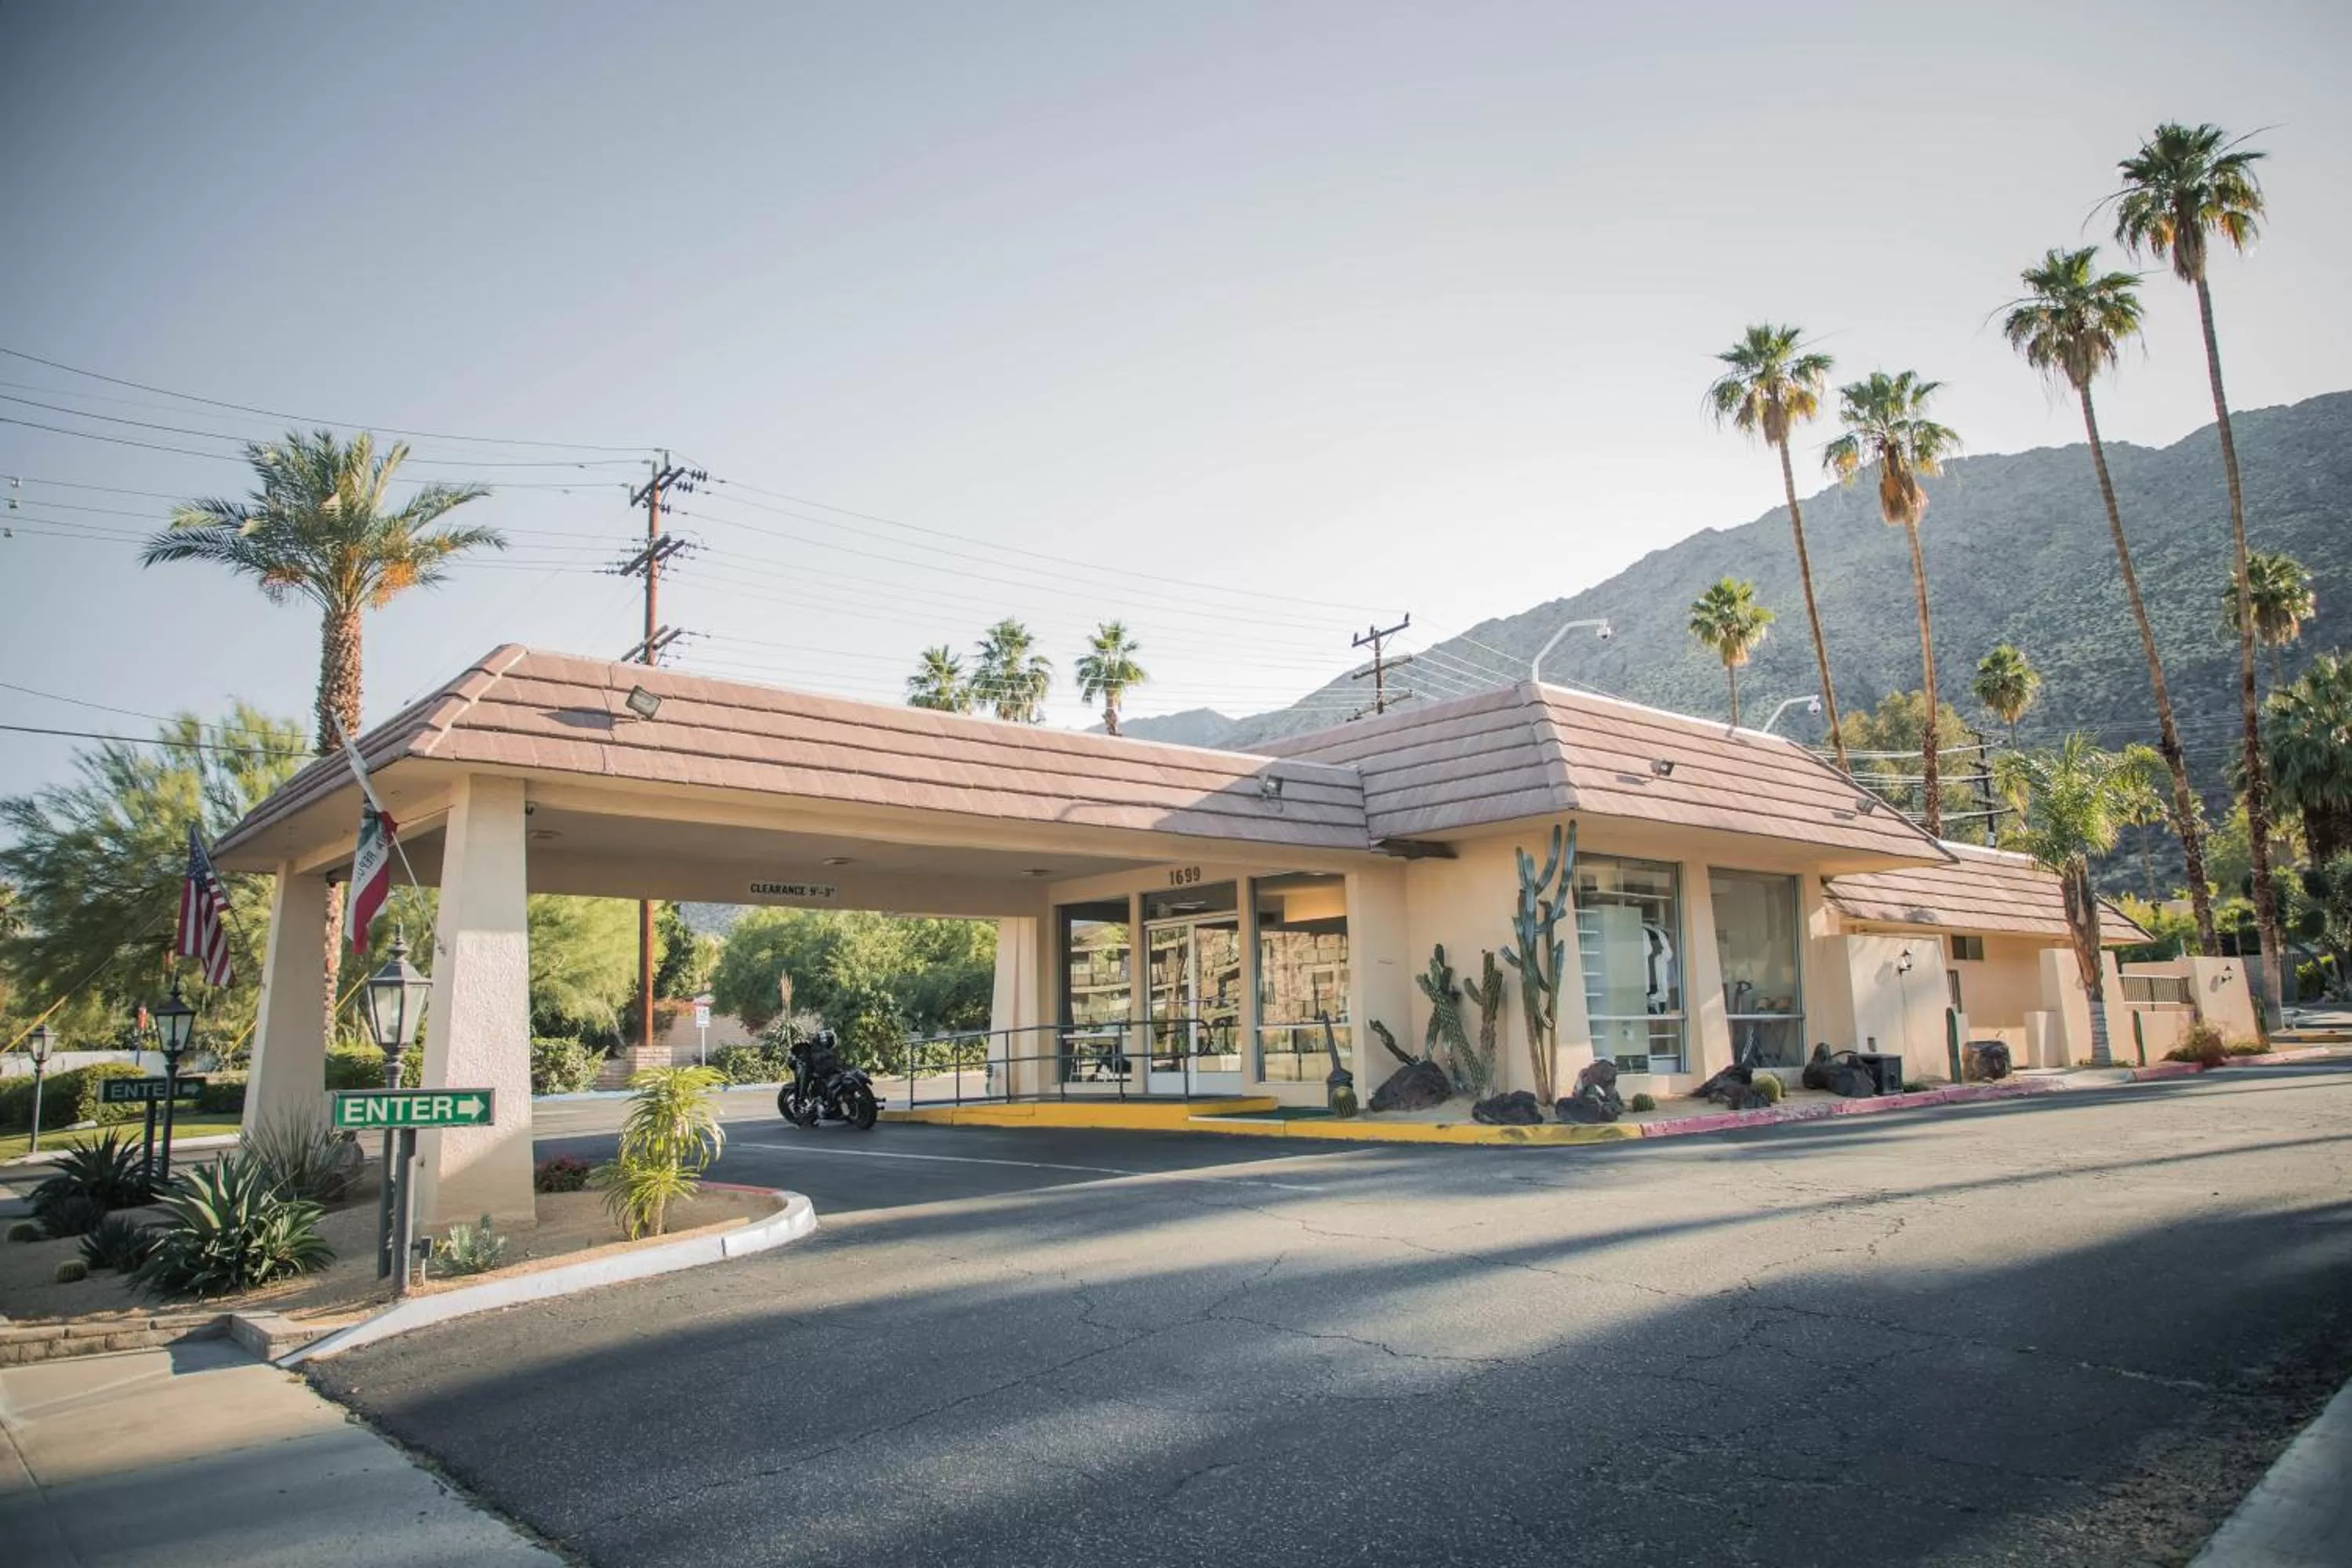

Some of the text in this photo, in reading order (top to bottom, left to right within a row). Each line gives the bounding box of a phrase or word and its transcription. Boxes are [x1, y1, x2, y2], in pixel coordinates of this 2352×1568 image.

[1169, 866, 1201, 885] 1699
[750, 884, 805, 895] CLEARANCE
[343, 1095, 453, 1123] ENTER
